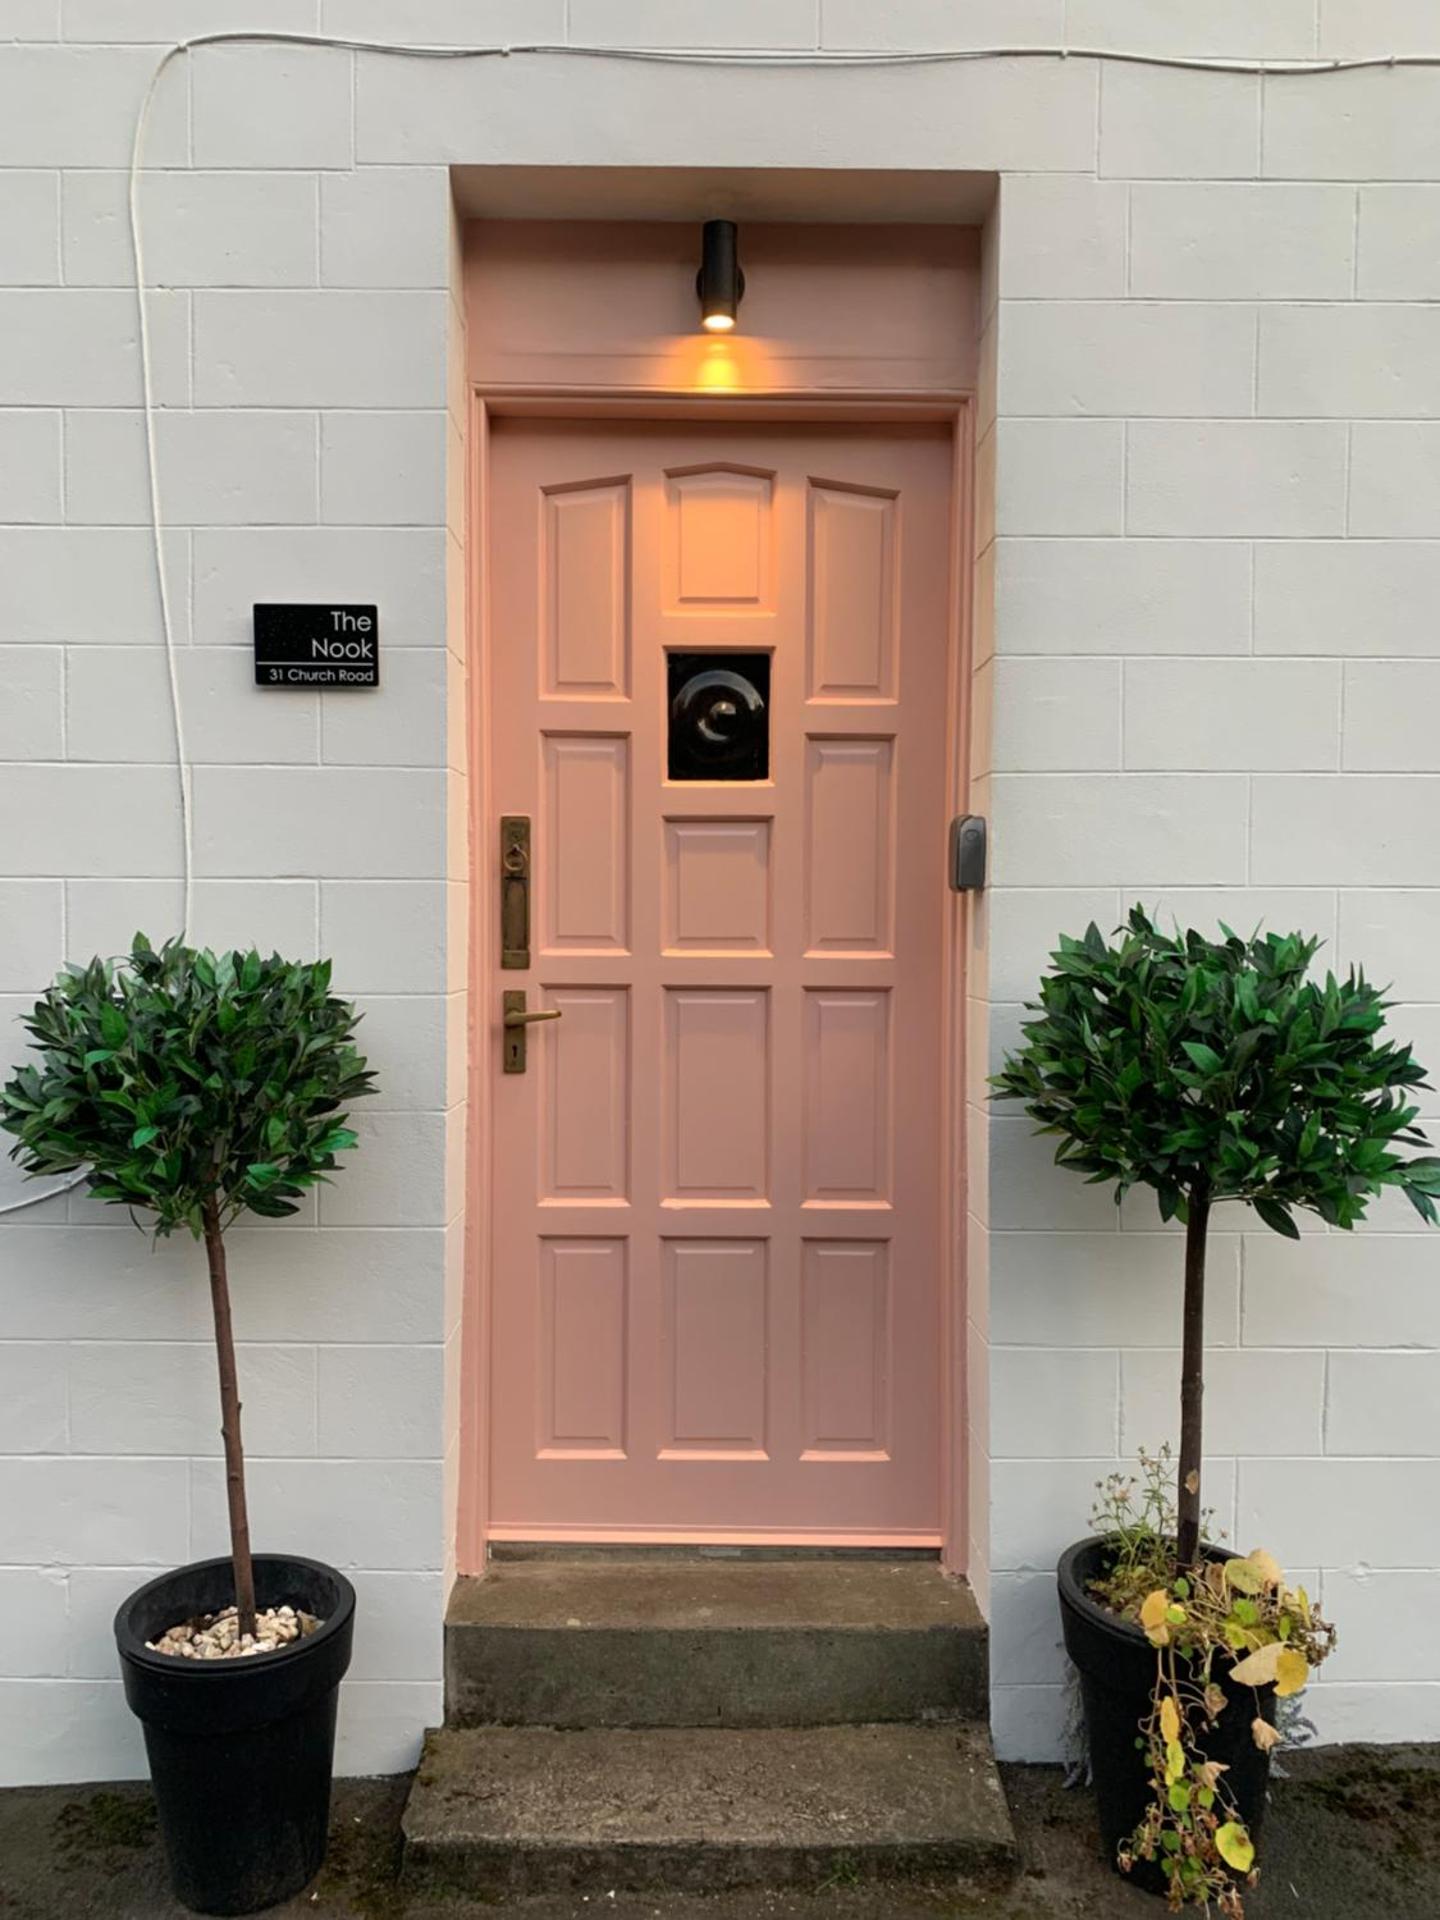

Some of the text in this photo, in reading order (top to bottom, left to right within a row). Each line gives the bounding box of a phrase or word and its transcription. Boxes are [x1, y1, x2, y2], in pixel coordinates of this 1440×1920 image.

[330, 611, 372, 632] The
[312, 638, 373, 658] Nook
[269, 668, 374, 682] 31 Church Road
